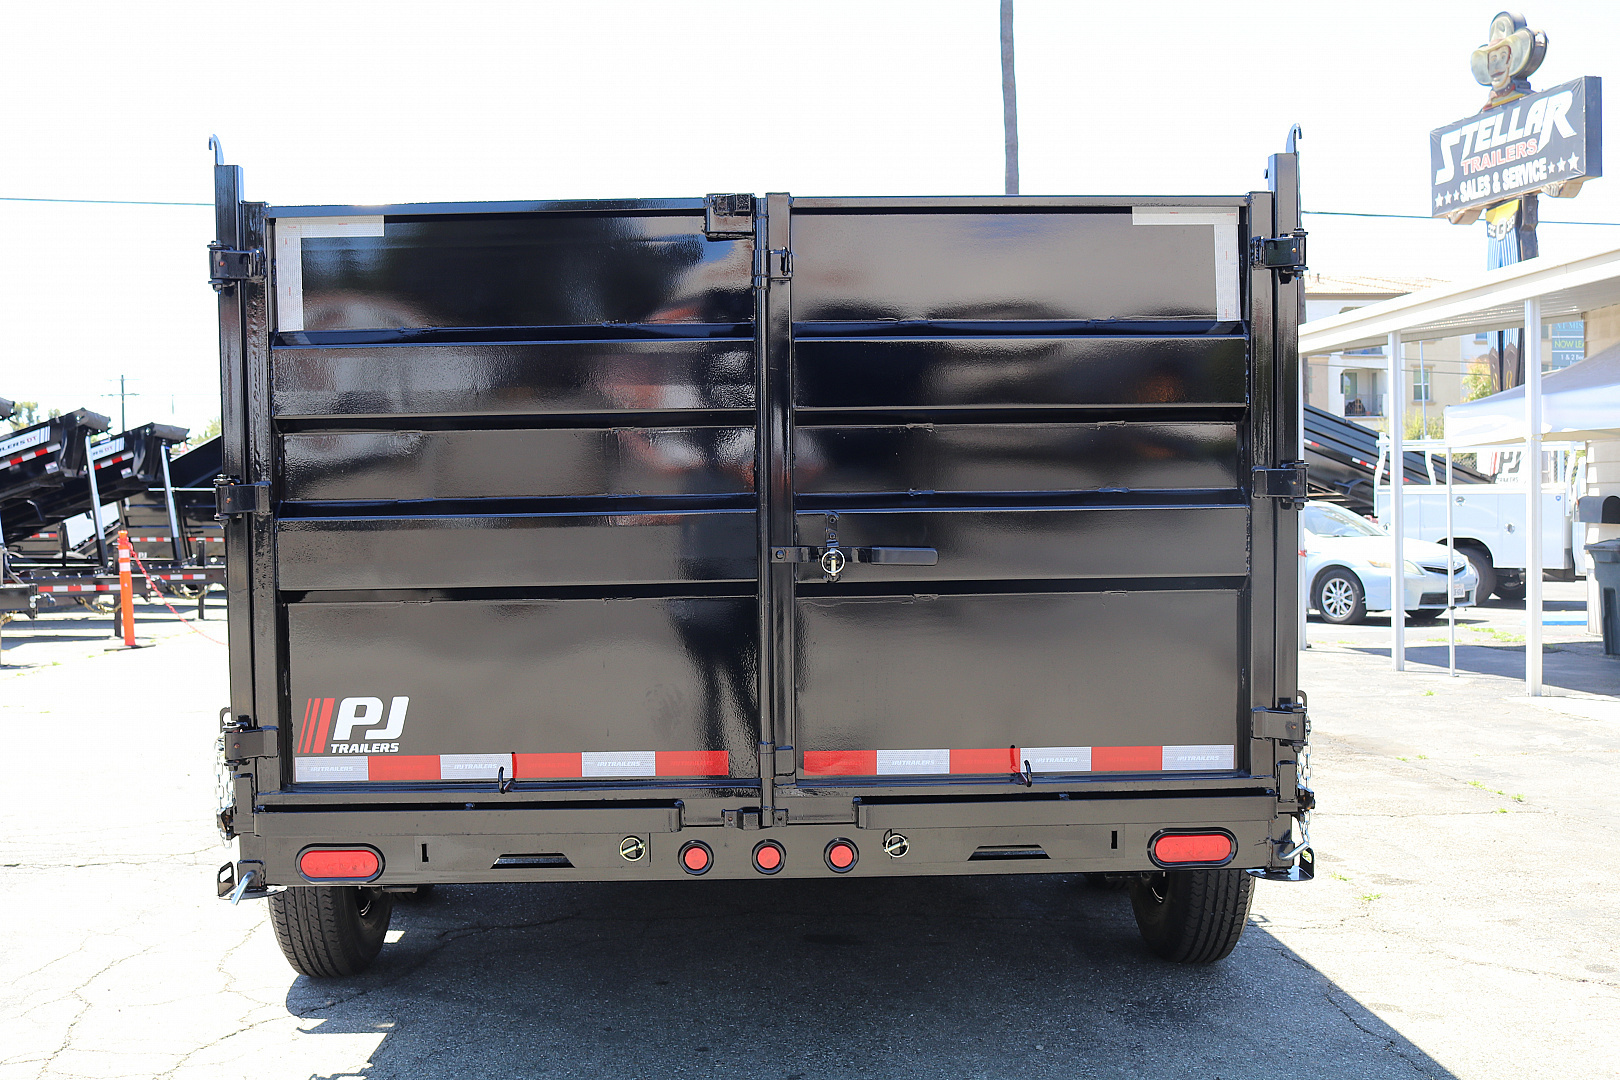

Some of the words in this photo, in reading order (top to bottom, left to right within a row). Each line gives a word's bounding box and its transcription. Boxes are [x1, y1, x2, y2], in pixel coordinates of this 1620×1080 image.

[1434, 90, 1577, 185] STELLAR
[1461, 138, 1538, 175] TRAILERS
[1459, 173, 1491, 203] SALES
[1492, 172, 1502, 194] &
[1502, 156, 1548, 191] SERVICE
[1554, 339, 1574, 349] NOW
[332, 695, 410, 741] PJ
[330, 742, 400, 754] TRAILERS
